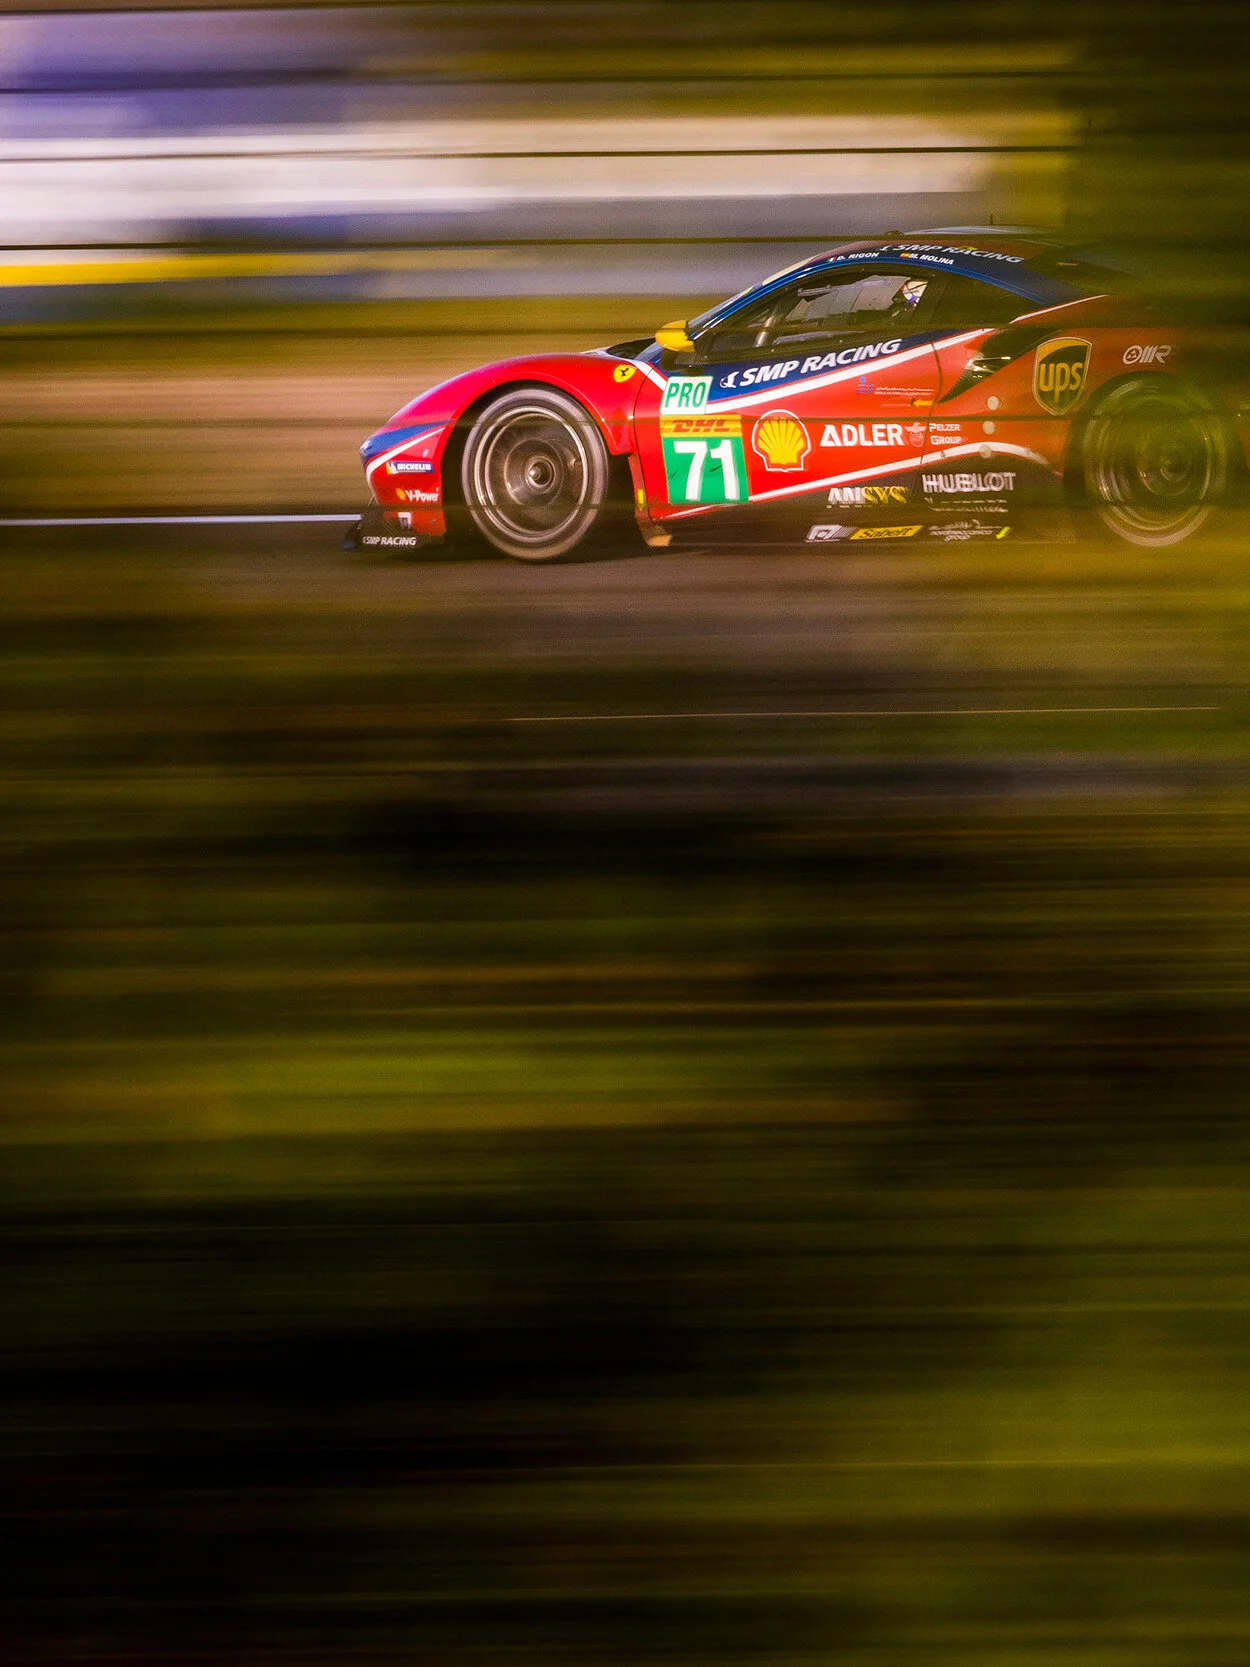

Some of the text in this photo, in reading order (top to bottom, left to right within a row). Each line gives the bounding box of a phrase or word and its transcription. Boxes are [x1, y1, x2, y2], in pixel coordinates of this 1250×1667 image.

[848, 252, 880, 260] RIGON
[893, 243, 1025, 263] SMP RACING
[920, 254, 955, 265] MOLINA
[740, 338, 902, 387] SMP RACING
[665, 381, 707, 408] PRO
[672, 419, 732, 433] DHL
[819, 423, 905, 447] ADLER
[396, 462, 432, 471] MICHELIN
[674, 439, 741, 501] 71
[922, 472, 1017, 493] HUBLOT
[405, 490, 439, 502] V-Power
[827, 486, 909, 504] ANSYS
[381, 536, 417, 546] RACING
